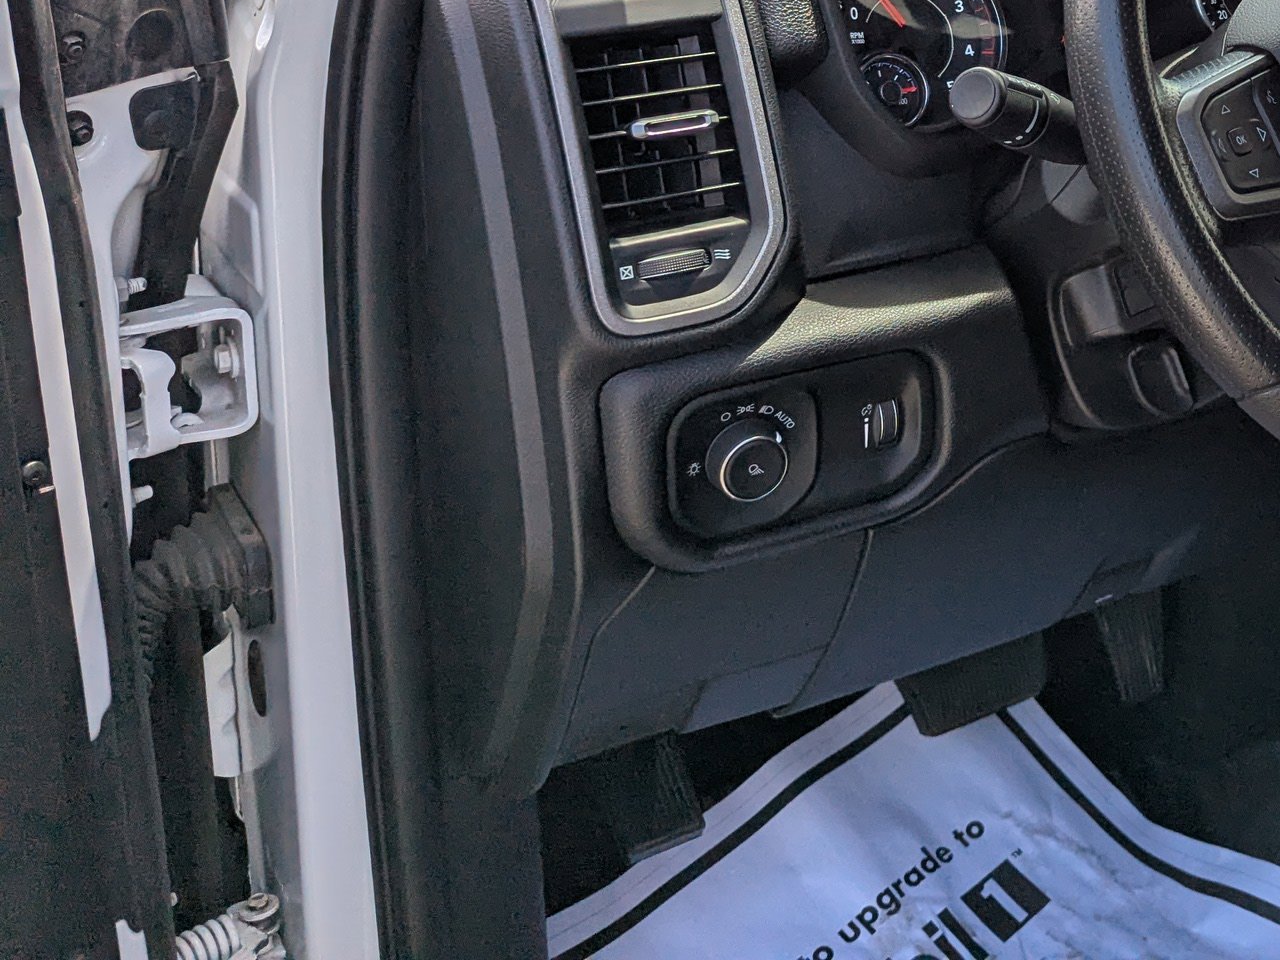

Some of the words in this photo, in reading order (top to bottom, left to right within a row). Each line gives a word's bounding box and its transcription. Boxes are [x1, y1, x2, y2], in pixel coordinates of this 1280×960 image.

[850, 6, 858, 20] 0
[954, 0, 964, 13] 3
[1217, 10, 1228, 20] 20
[964, 44, 975, 57] 4
[1236, 135, 1247, 145] OK
[774, 410, 795, 429] AUTO
[838, 846, 954, 943] upgrade
[952, 820, 985, 848] to
